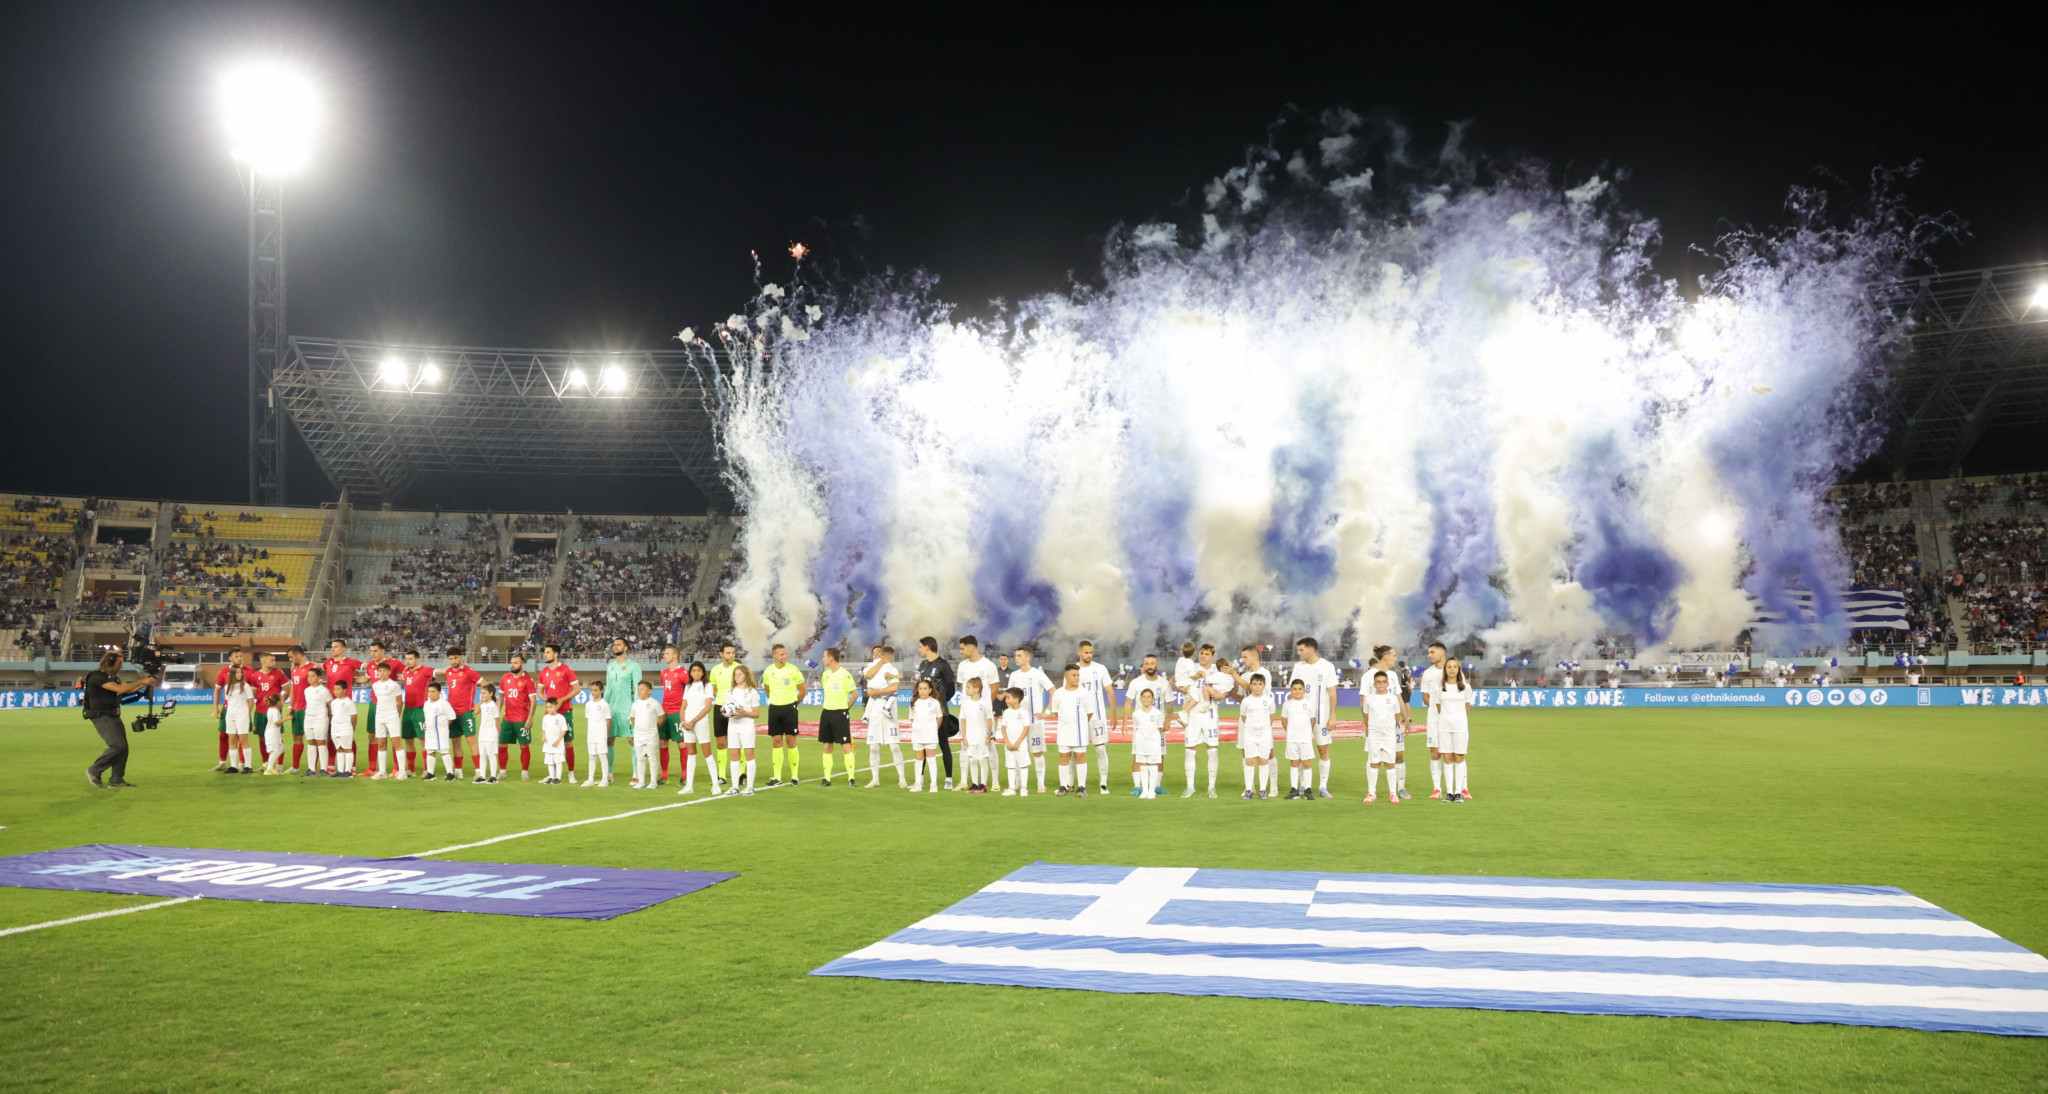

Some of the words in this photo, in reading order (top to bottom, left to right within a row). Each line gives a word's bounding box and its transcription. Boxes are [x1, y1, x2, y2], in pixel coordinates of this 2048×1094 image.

[293, 676, 300, 685] 19
[549, 680, 556, 690] 4
[664, 680, 672, 690] 14
[260, 682, 270, 692] 18
[508, 688, 519, 698] 20
[1498, 690, 1545, 706] PLAY
[1553, 691, 1577, 706] AS
[1587, 690, 1625, 706] ONE
[1644, 693, 1676, 702] Follow
[1691, 693, 1765, 703] @ethnikiomada
[1961, 688, 1995, 705] WE
[22, 692, 64, 707] PLAY
[466, 718, 474, 729] 3
[889, 727, 898, 736] 11
[1094, 727, 1104, 737] 17
[1208, 728, 1218, 738] 15
[1031, 737, 1041, 746] 26
